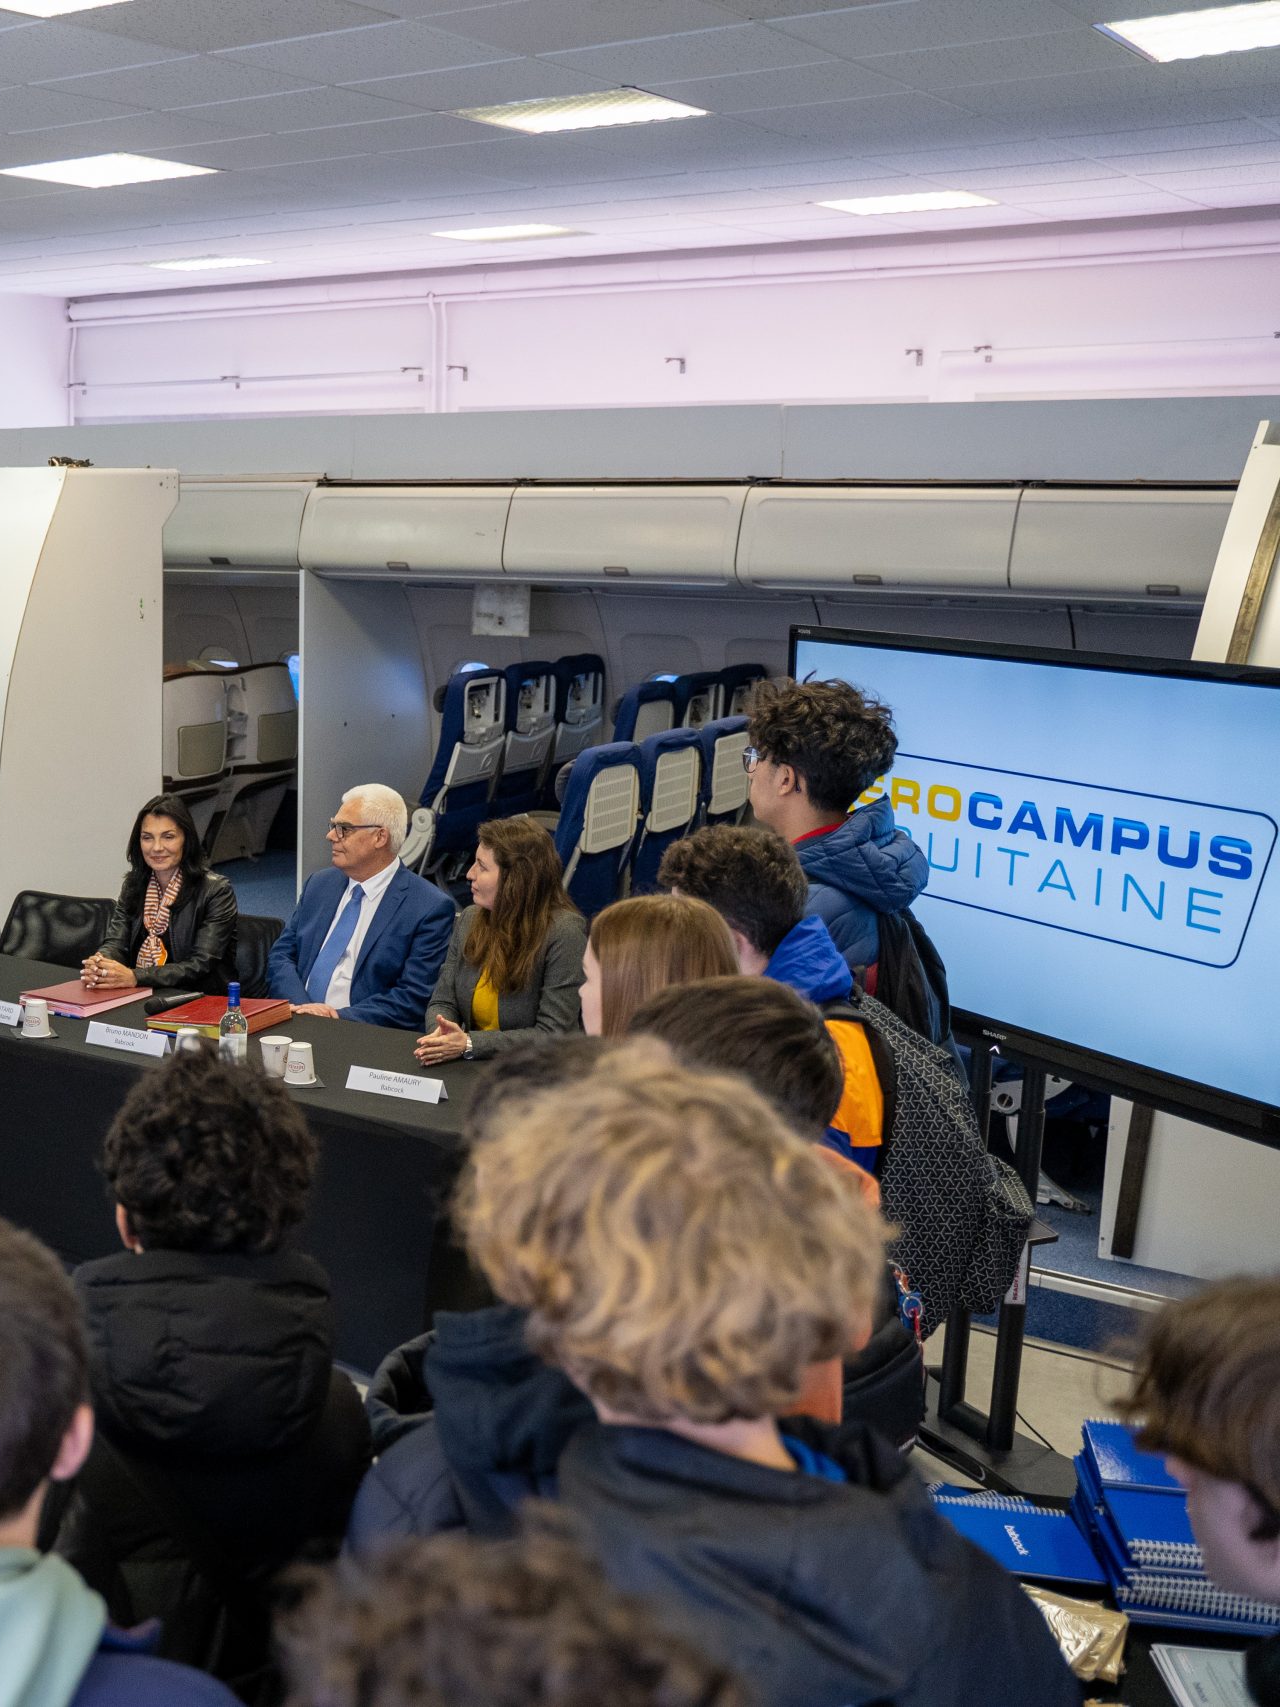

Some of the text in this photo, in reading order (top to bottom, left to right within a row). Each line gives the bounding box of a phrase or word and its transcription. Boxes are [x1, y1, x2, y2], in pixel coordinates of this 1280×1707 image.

[847, 775, 1253, 881] EROCAMPUS
[895, 824, 1224, 935] UITAINE
[105, 1026, 149, 1040] Bruno MANDON
[982, 1029, 1007, 1040] SHARP
[114, 1038, 136, 1047] Babcock
[368, 1071, 422, 1087] Pauline AMAURY
[380, 1083, 405, 1094] Babcock
